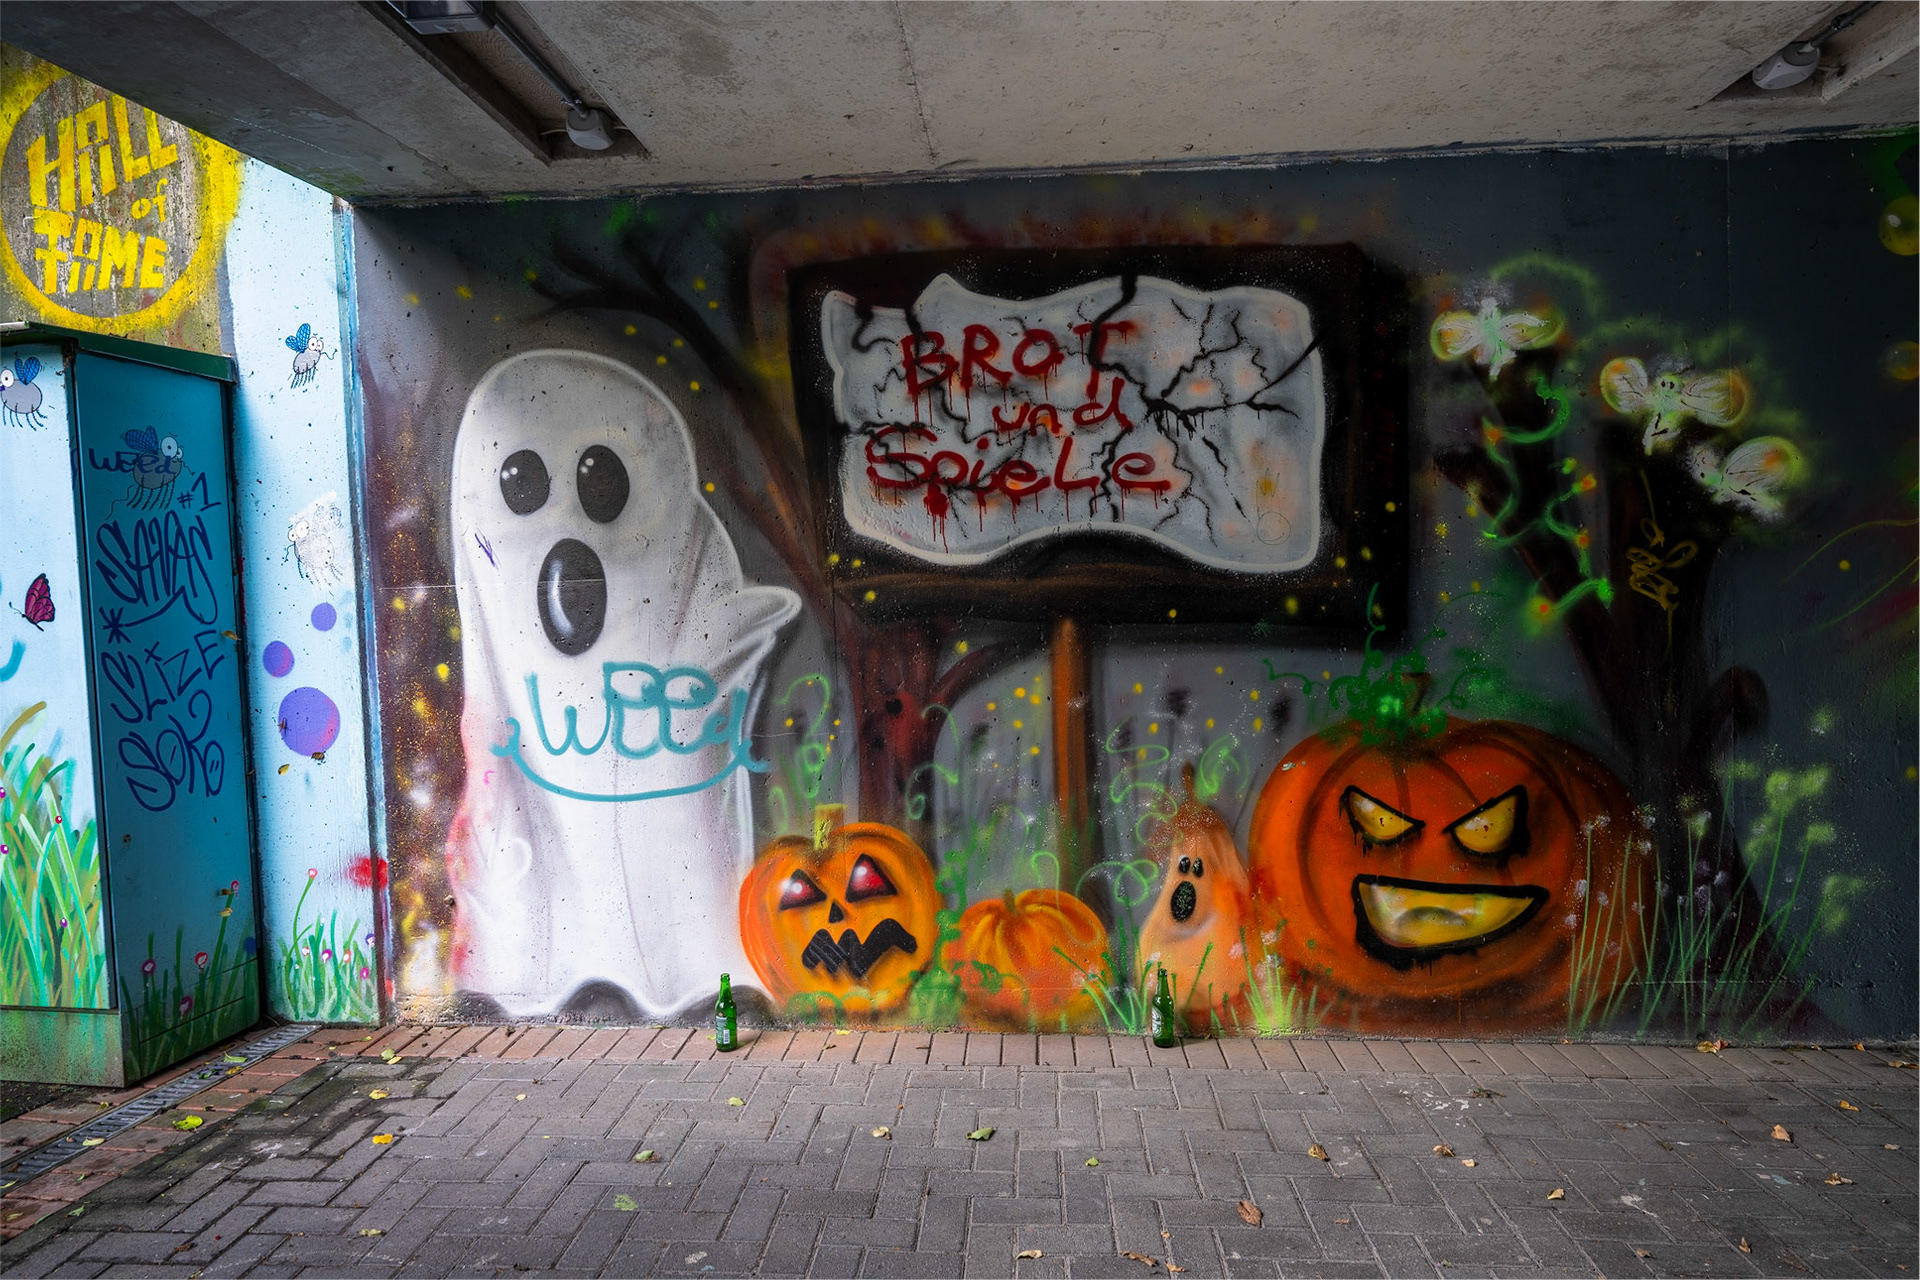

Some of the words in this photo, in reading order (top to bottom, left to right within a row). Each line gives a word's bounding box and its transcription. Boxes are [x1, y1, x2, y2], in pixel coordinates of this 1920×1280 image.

[131, 178, 168, 222] of
[902, 320, 1136, 400] BROT
[993, 377, 1134, 436] und
